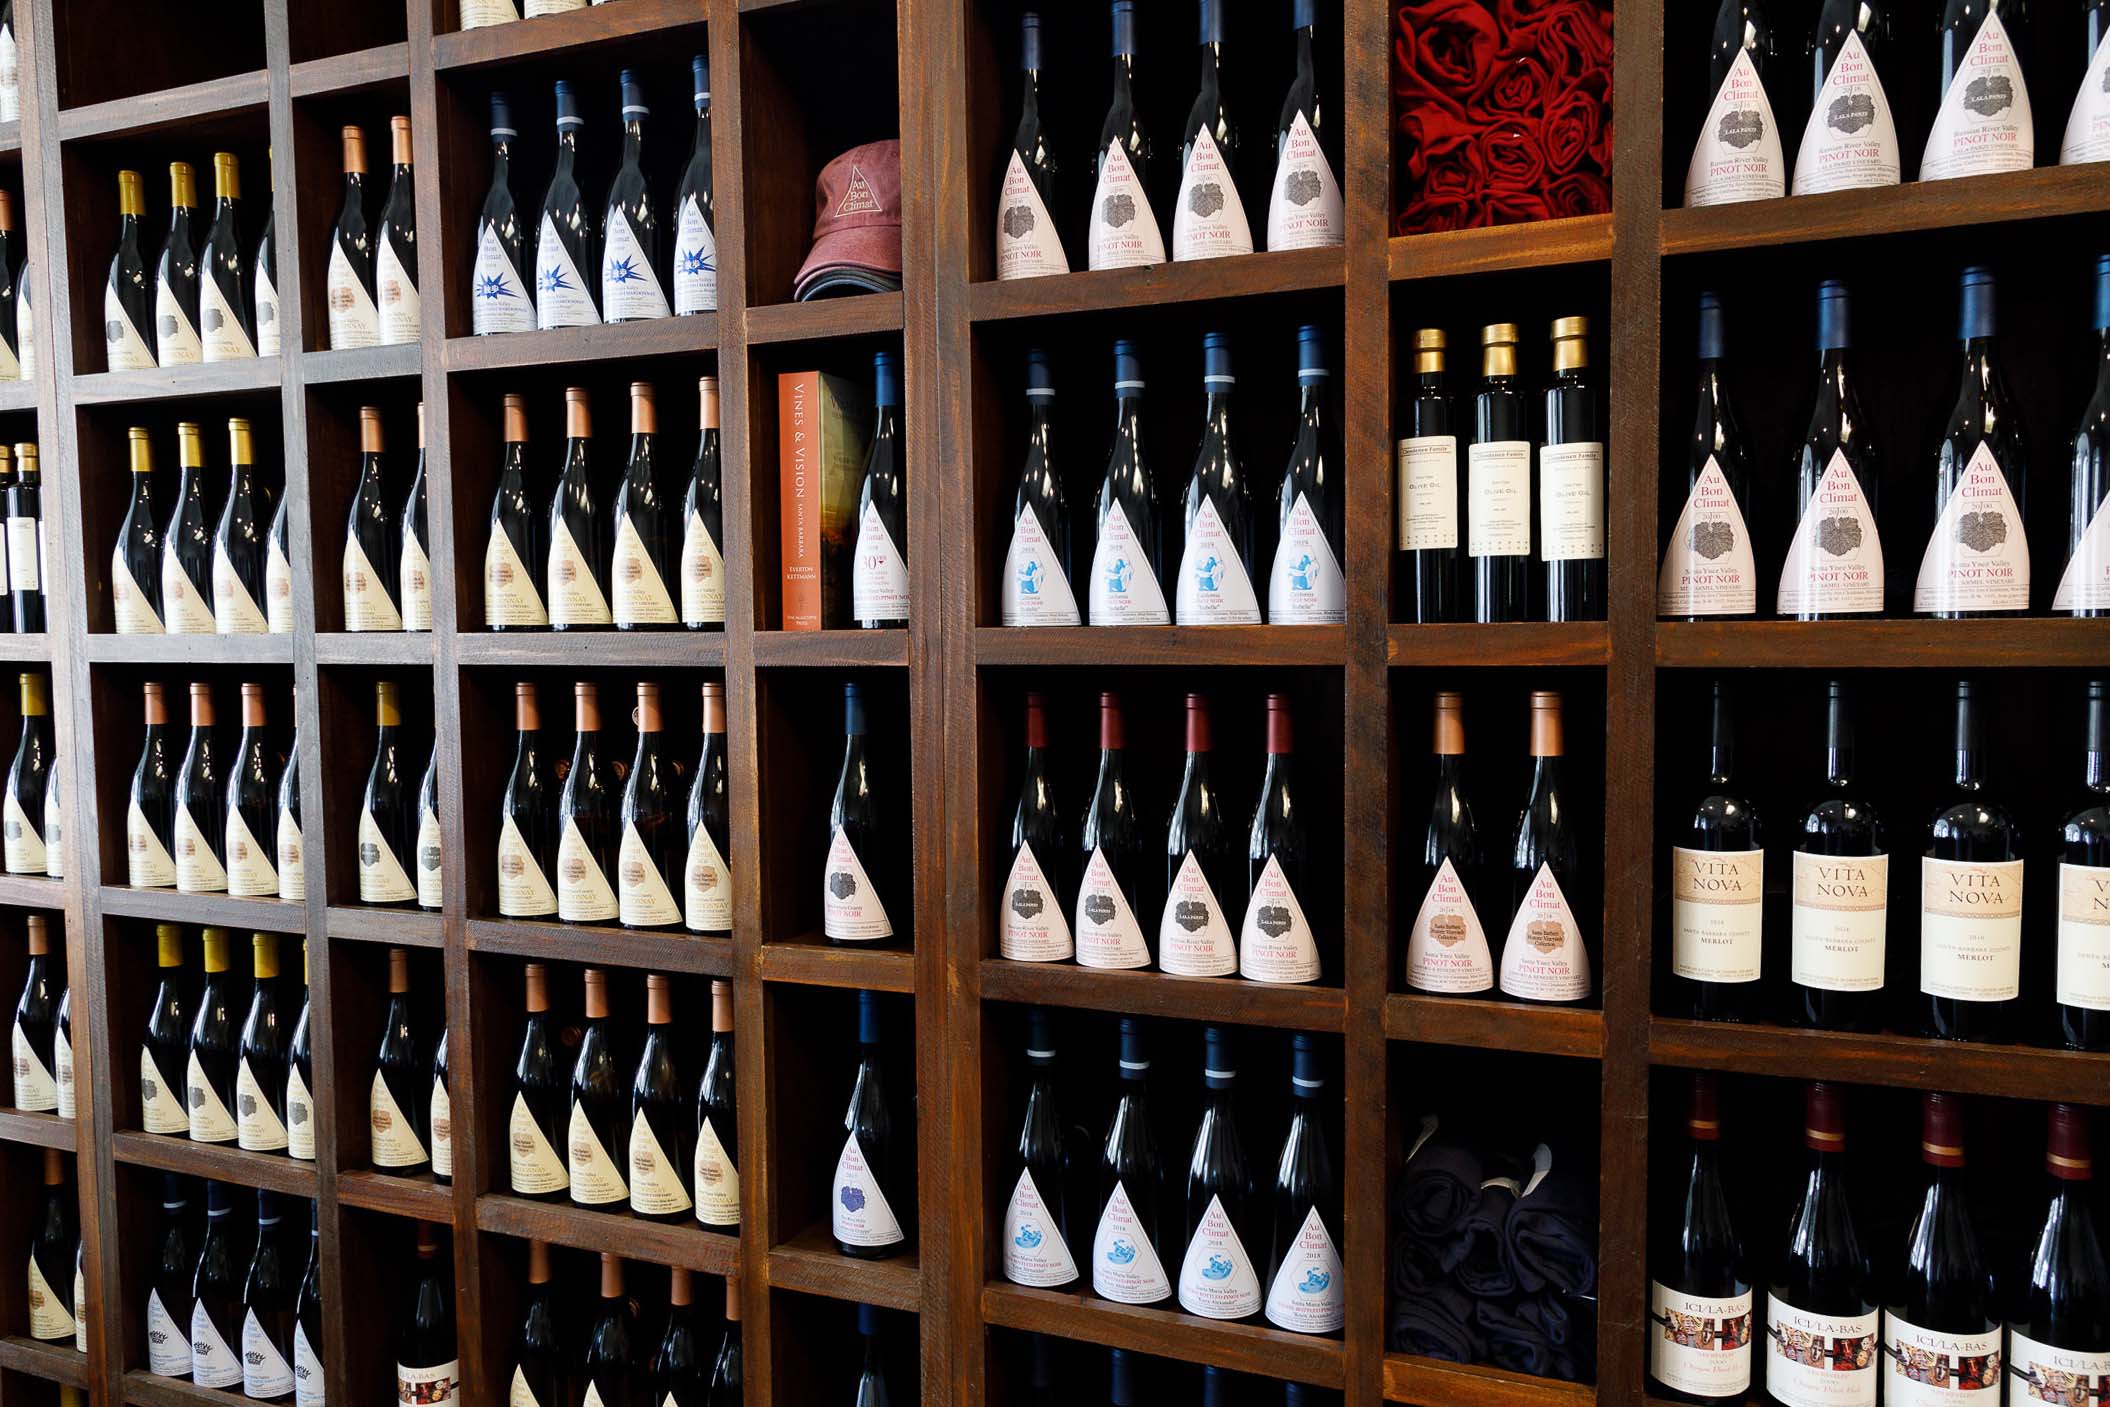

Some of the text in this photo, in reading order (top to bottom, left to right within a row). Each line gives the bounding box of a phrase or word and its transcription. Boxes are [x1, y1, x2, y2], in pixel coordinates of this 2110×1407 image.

[1983, 31, 1999, 40] Au
[1979, 43, 2003, 53] Bon
[1844, 50, 1860, 60] Au
[1970, 55, 2008, 66] Climat
[1841, 62, 1863, 72] Bon
[1734, 67, 1750, 78] Au
[1731, 78, 1753, 89] Bon
[1832, 74, 1870, 85] Climat
[1723, 91, 1759, 102] Climat
[1295, 128, 1307, 137] Au
[2001, 124, 2019, 132] Valley
[1291, 138, 1310, 149] Bon
[1863, 140, 1881, 148] Valley
[1954, 132, 2017, 148] PINOT NOIR
[1199, 141, 1211, 150] Au
[1110, 153, 1122, 162] Au
[1195, 151, 1214, 161] Bon
[1286, 149, 1316, 160] Climat
[1752, 155, 1768, 163] Valley
[1819, 149, 1880, 162] PINOT NOIR
[1011, 166, 1022, 176] Au
[1107, 163, 1125, 173] Bon
[1190, 161, 1220, 172] Climat
[1710, 163, 1768, 177] PINOT NOIR
[1008, 175, 1025, 185] Bon
[1102, 173, 1131, 184] Climat
[853, 181, 866, 191] Au
[1004, 185, 1030, 196] Climat
[850, 191, 868, 200] Bon
[842, 200, 873, 212] Climat
[1306, 218, 1329, 229] NOIR
[1209, 229, 1232, 240] NOIR
[1121, 239, 1143, 249] NOIR
[1021, 250, 1042, 260] NOIR
[793, 383, 806, 498] VINES & VISION
[1428, 445, 1448, 453] Family
[1578, 452, 1597, 460] Family
[1975, 461, 1992, 471] Au
[1831, 469, 1847, 479] Au
[1704, 475, 1720, 484] Au
[1970, 474, 1995, 485] Bon
[1827, 481, 1850, 491] Bon
[1701, 486, 1723, 497] Bon
[1961, 486, 2003, 498] Climat
[1693, 498, 1730, 509] Climat
[1819, 493, 1858, 504] Climat
[1847, 563, 1865, 571] Valley
[1991, 560, 2011, 568] Valley
[1720, 567, 1737, 575] Valley
[1843, 570, 1869, 581] NOIR
[1986, 567, 2014, 578] NOIR
[1682, 573, 1741, 585] PINOT NOIR
[1021, 855, 1032, 864] Au
[1093, 860, 1104, 868] Au
[1018, 864, 1034, 873] Bon
[1091, 869, 1106, 878] Bon
[1184, 865, 1197, 874] Au
[1695, 862, 1738, 875] VITA
[1819, 866, 1865, 881] VITA
[1013, 873, 1039, 881] Climat
[1183, 875, 1199, 883] Bon
[1266, 870, 1279, 879] Au
[1440, 874, 1454, 883] Au
[1087, 877, 1111, 887] Climat
[1264, 879, 1281, 888] Bon
[1538, 879, 1553, 889] Au
[1693, 878, 1742, 891] NOVA
[1951, 873, 2001, 887] VITA
[1178, 883, 1204, 893] Climat
[1259, 887, 1287, 898] Climat
[1437, 883, 1457, 894] Bon
[1817, 883, 1868, 897] NOVA
[1431, 893, 1462, 904] Climat
[1535, 889, 1555, 899] Bon
[1949, 890, 2003, 904] NOVA
[1528, 898, 1561, 909] Climat
[1100, 937, 1121, 945] NOIR
[1700, 937, 1733, 945] MERLOT
[1191, 944, 1215, 953] NOIR
[1824, 945, 1860, 953] MERLOT
[1274, 950, 1297, 959] NOIR
[1957, 953, 1993, 961] MERLOT
[1423, 959, 1473, 968] PINOT NOIR
[1519, 964, 1570, 975] PINOT NOIR
[847, 1147, 857, 1155] Au
[845, 1154, 859, 1163] Bon
[842, 1162, 864, 1171] Climat
[1022, 1182, 1031, 1191] Au
[1019, 1191, 1034, 1199] Bon
[1115, 1195, 1127, 1204] Au
[1015, 1198, 1039, 1209] Climat
[1112, 1204, 1128, 1214] Bon
[1107, 1213, 1132, 1224] Climat
[1209, 1211, 1222, 1219] Au
[1207, 1220, 1224, 1228] Bon
[1307, 1223, 1320, 1231] Au
[1202, 1228, 1229, 1238] Climat
[1305, 1231, 1322, 1240] Bon
[1298, 1239, 1328, 1249] Climat
[1685, 1301, 1746, 1315] ICI/LA-BAS
[1793, 1315, 1863, 1334] ICI/LA-BAS
[1915, 1333, 1988, 1352] ICI/LA-BAS
